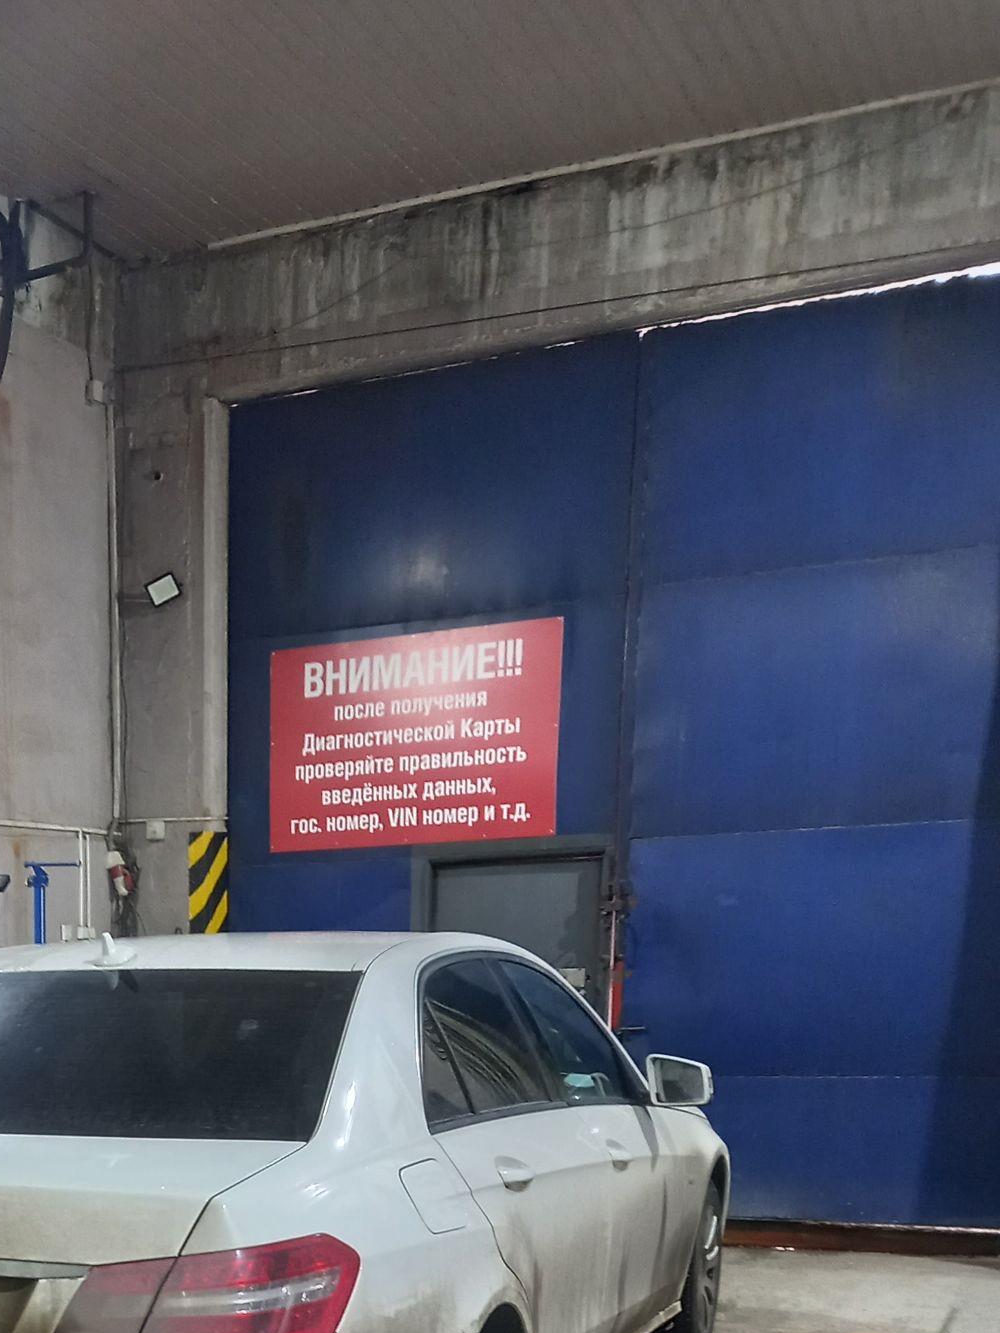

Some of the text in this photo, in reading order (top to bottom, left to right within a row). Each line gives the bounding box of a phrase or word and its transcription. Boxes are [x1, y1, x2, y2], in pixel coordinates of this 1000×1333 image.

[303, 638, 524, 698] ВНИМАНИЕ!!!
[334, 690, 488, 721] после получения
[302, 717, 521, 756] Диагностической Карты
[295, 745, 528, 784] проверяйте правильность
[321, 776, 496, 806] введённых данных,
[290, 801, 531, 834] гос. номер, VIN номер и т.д.
